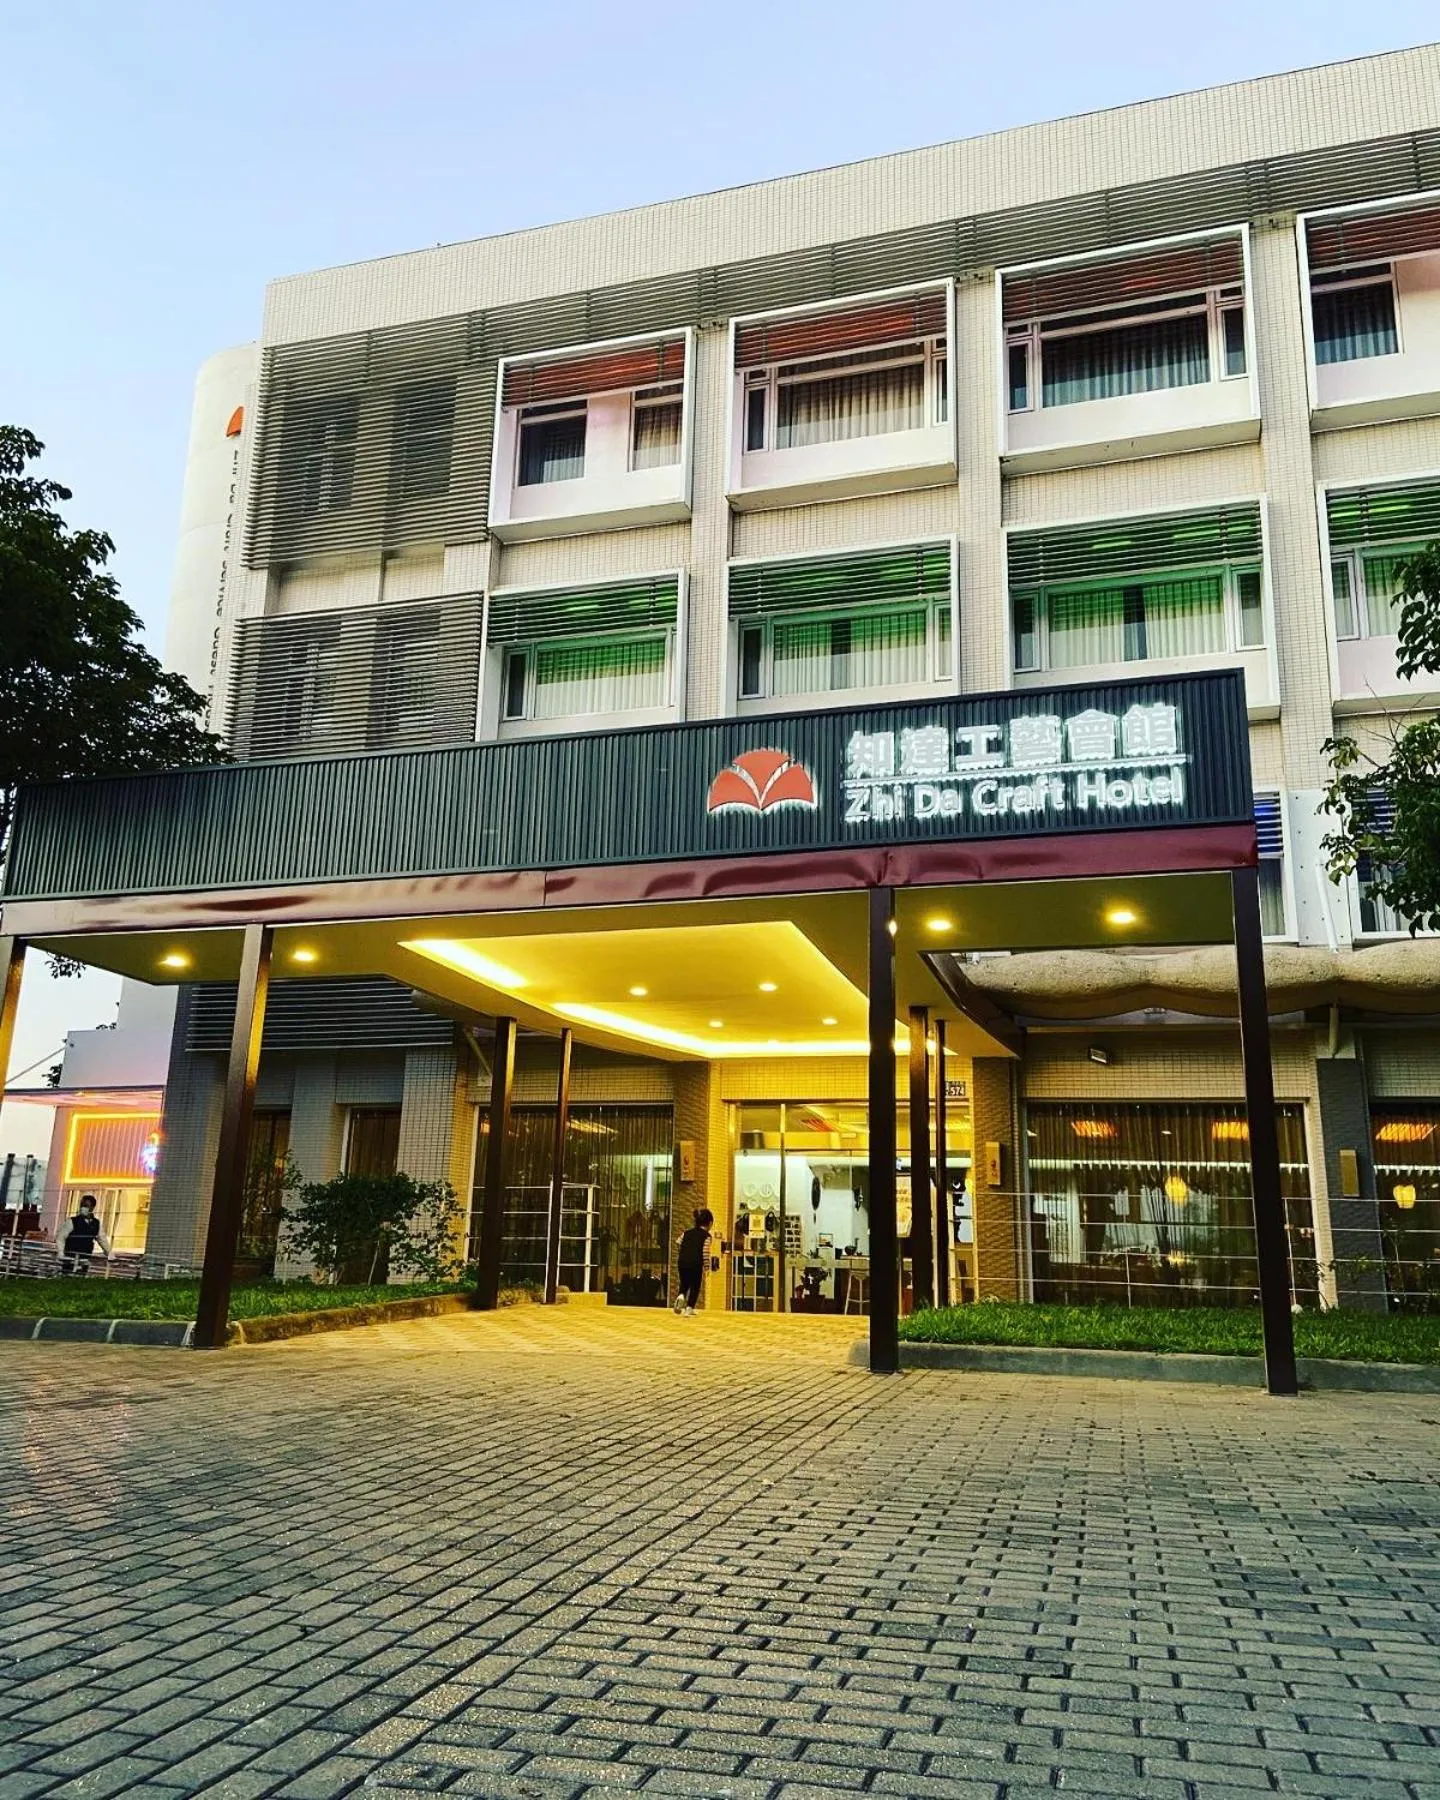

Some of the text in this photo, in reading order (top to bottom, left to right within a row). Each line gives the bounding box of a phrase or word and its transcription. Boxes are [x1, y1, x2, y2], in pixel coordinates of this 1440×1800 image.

[847, 702, 1177, 777] 知達工藝會館
[845, 766, 1184, 822] Zhi Da Craft Hotel
